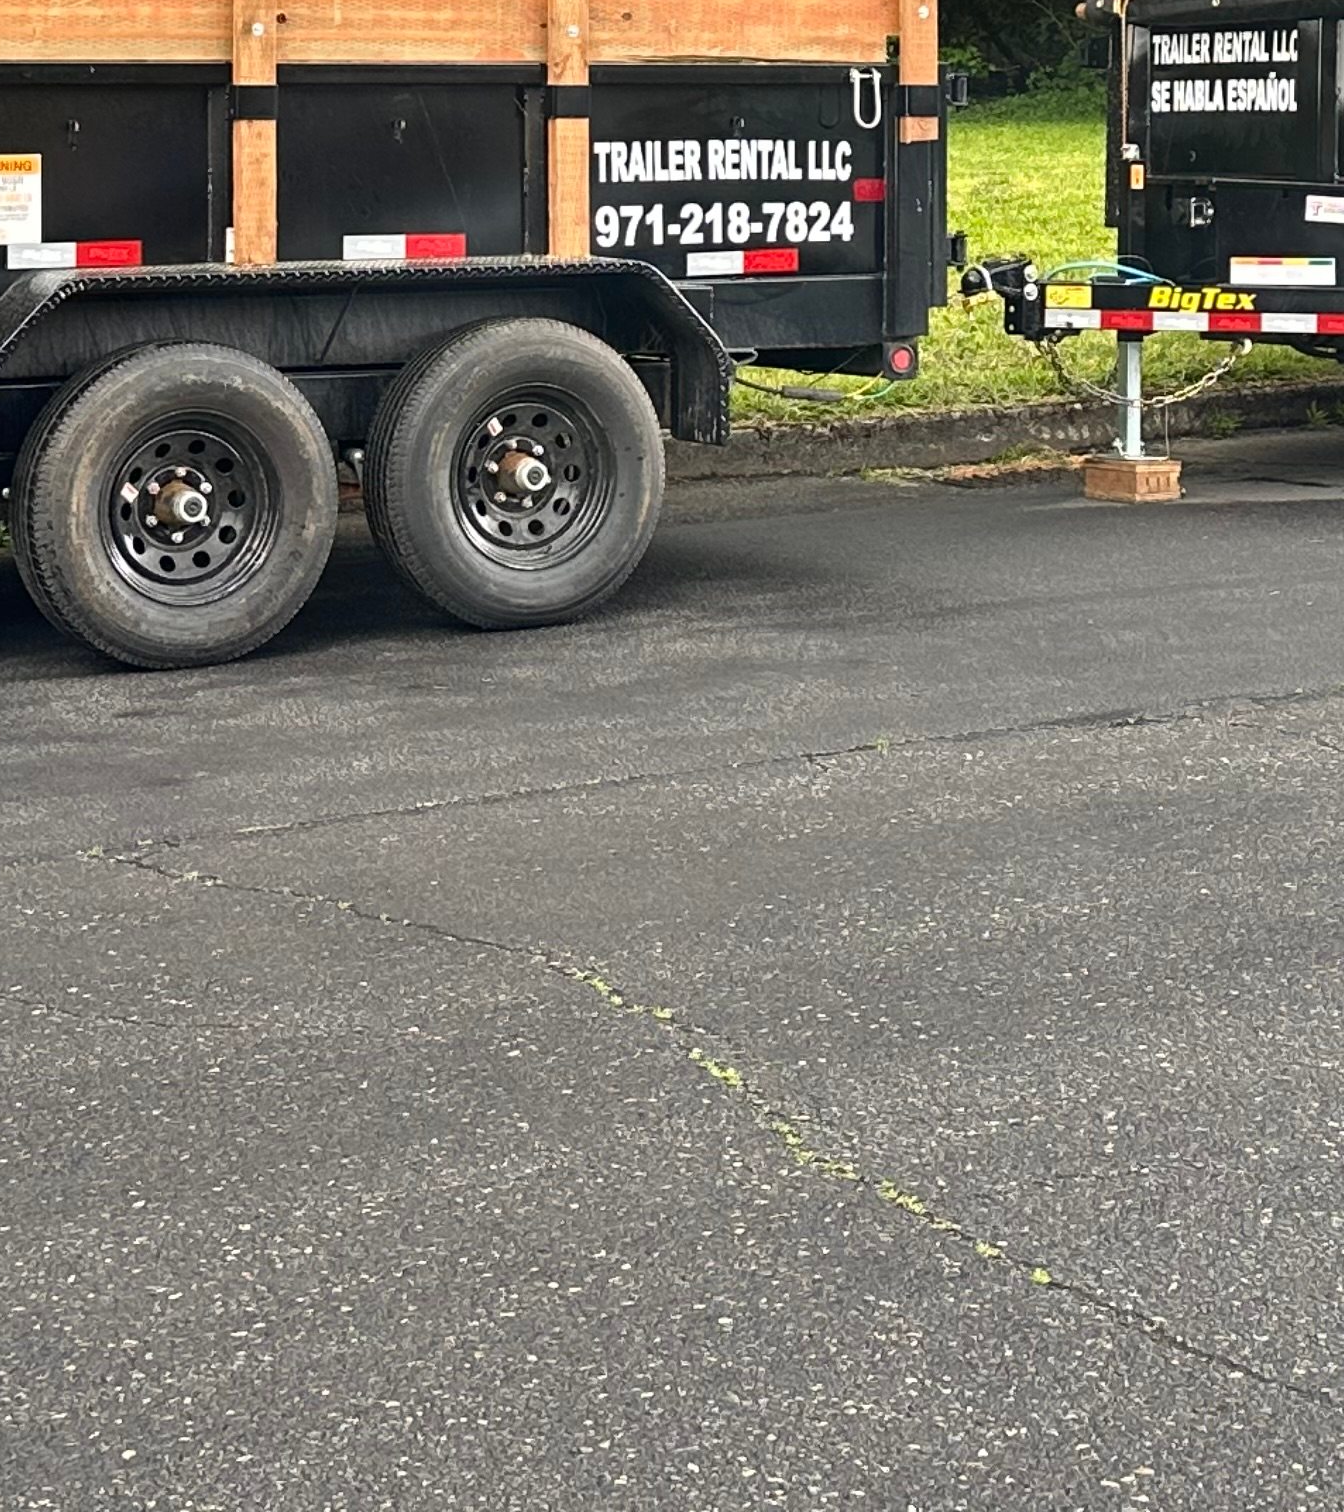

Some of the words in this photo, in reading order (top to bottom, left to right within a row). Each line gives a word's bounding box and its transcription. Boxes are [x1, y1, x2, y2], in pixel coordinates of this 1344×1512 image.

[1152, 32, 1211, 65] TRAILER
[1212, 30, 1270, 63] RENTAL
[1271, 29, 1299, 63] LLC
[1151, 80, 1171, 113] SE
[1172, 78, 1225, 112] HABLA
[1226, 71, 1298, 112] ESPAÑOL
[593, 140, 702, 183] TRAILER
[707, 139, 802, 180] RENTAL
[807, 140, 852, 181] LLC
[594, 200, 855, 248] 971-218-7824
[1148, 286, 1257, 313] BigTex
